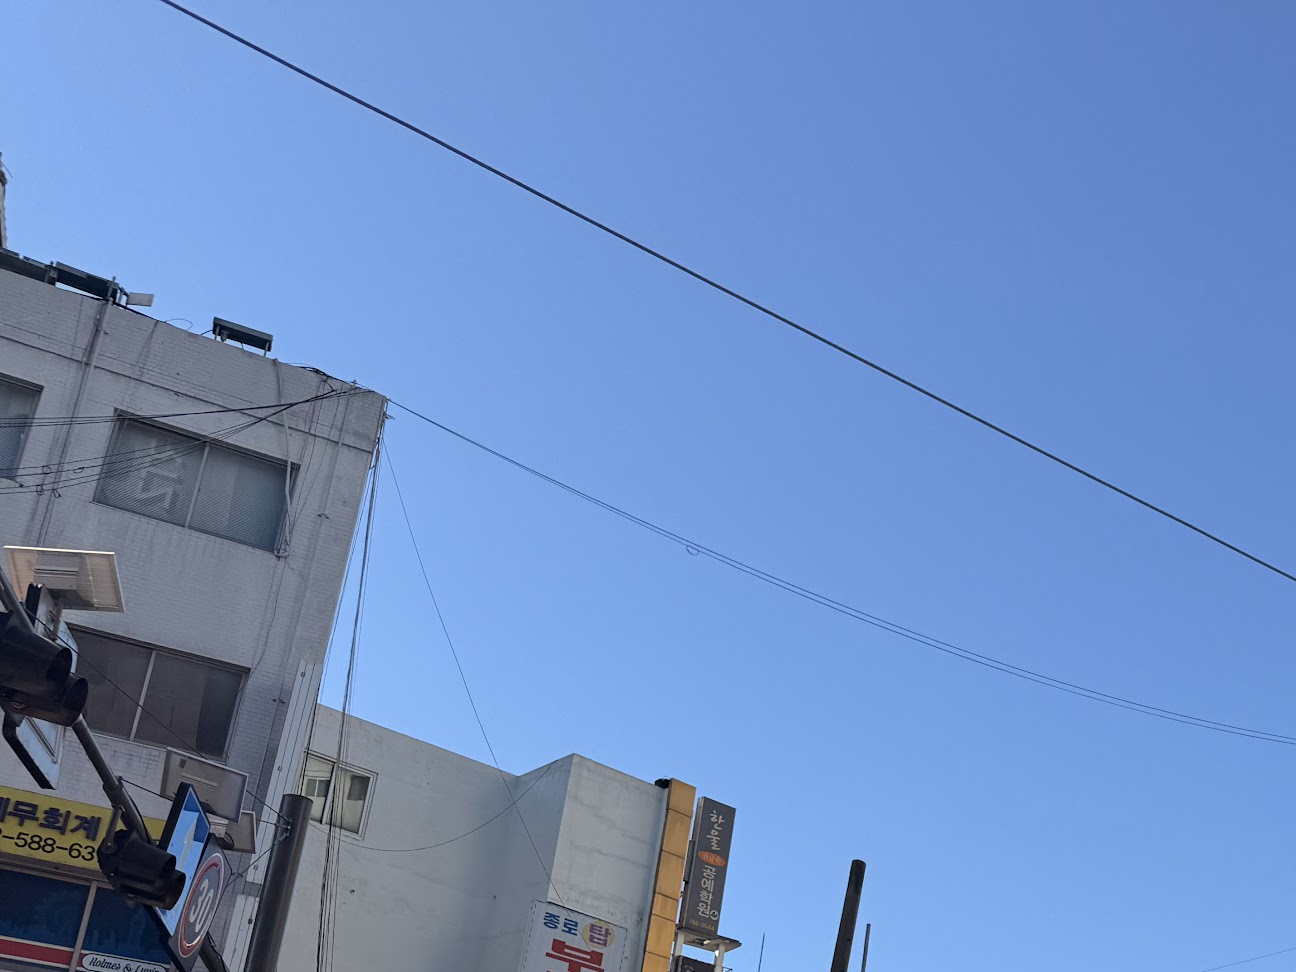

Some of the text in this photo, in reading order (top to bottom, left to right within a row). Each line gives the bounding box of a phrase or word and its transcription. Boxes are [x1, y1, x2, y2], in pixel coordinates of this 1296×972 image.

[0, 828, 99, 862] -588-63
[190, 878, 214, 933] 30
[543, 911, 612, 948] 종로 탑
[89, 957, 121, 971] Holmes
